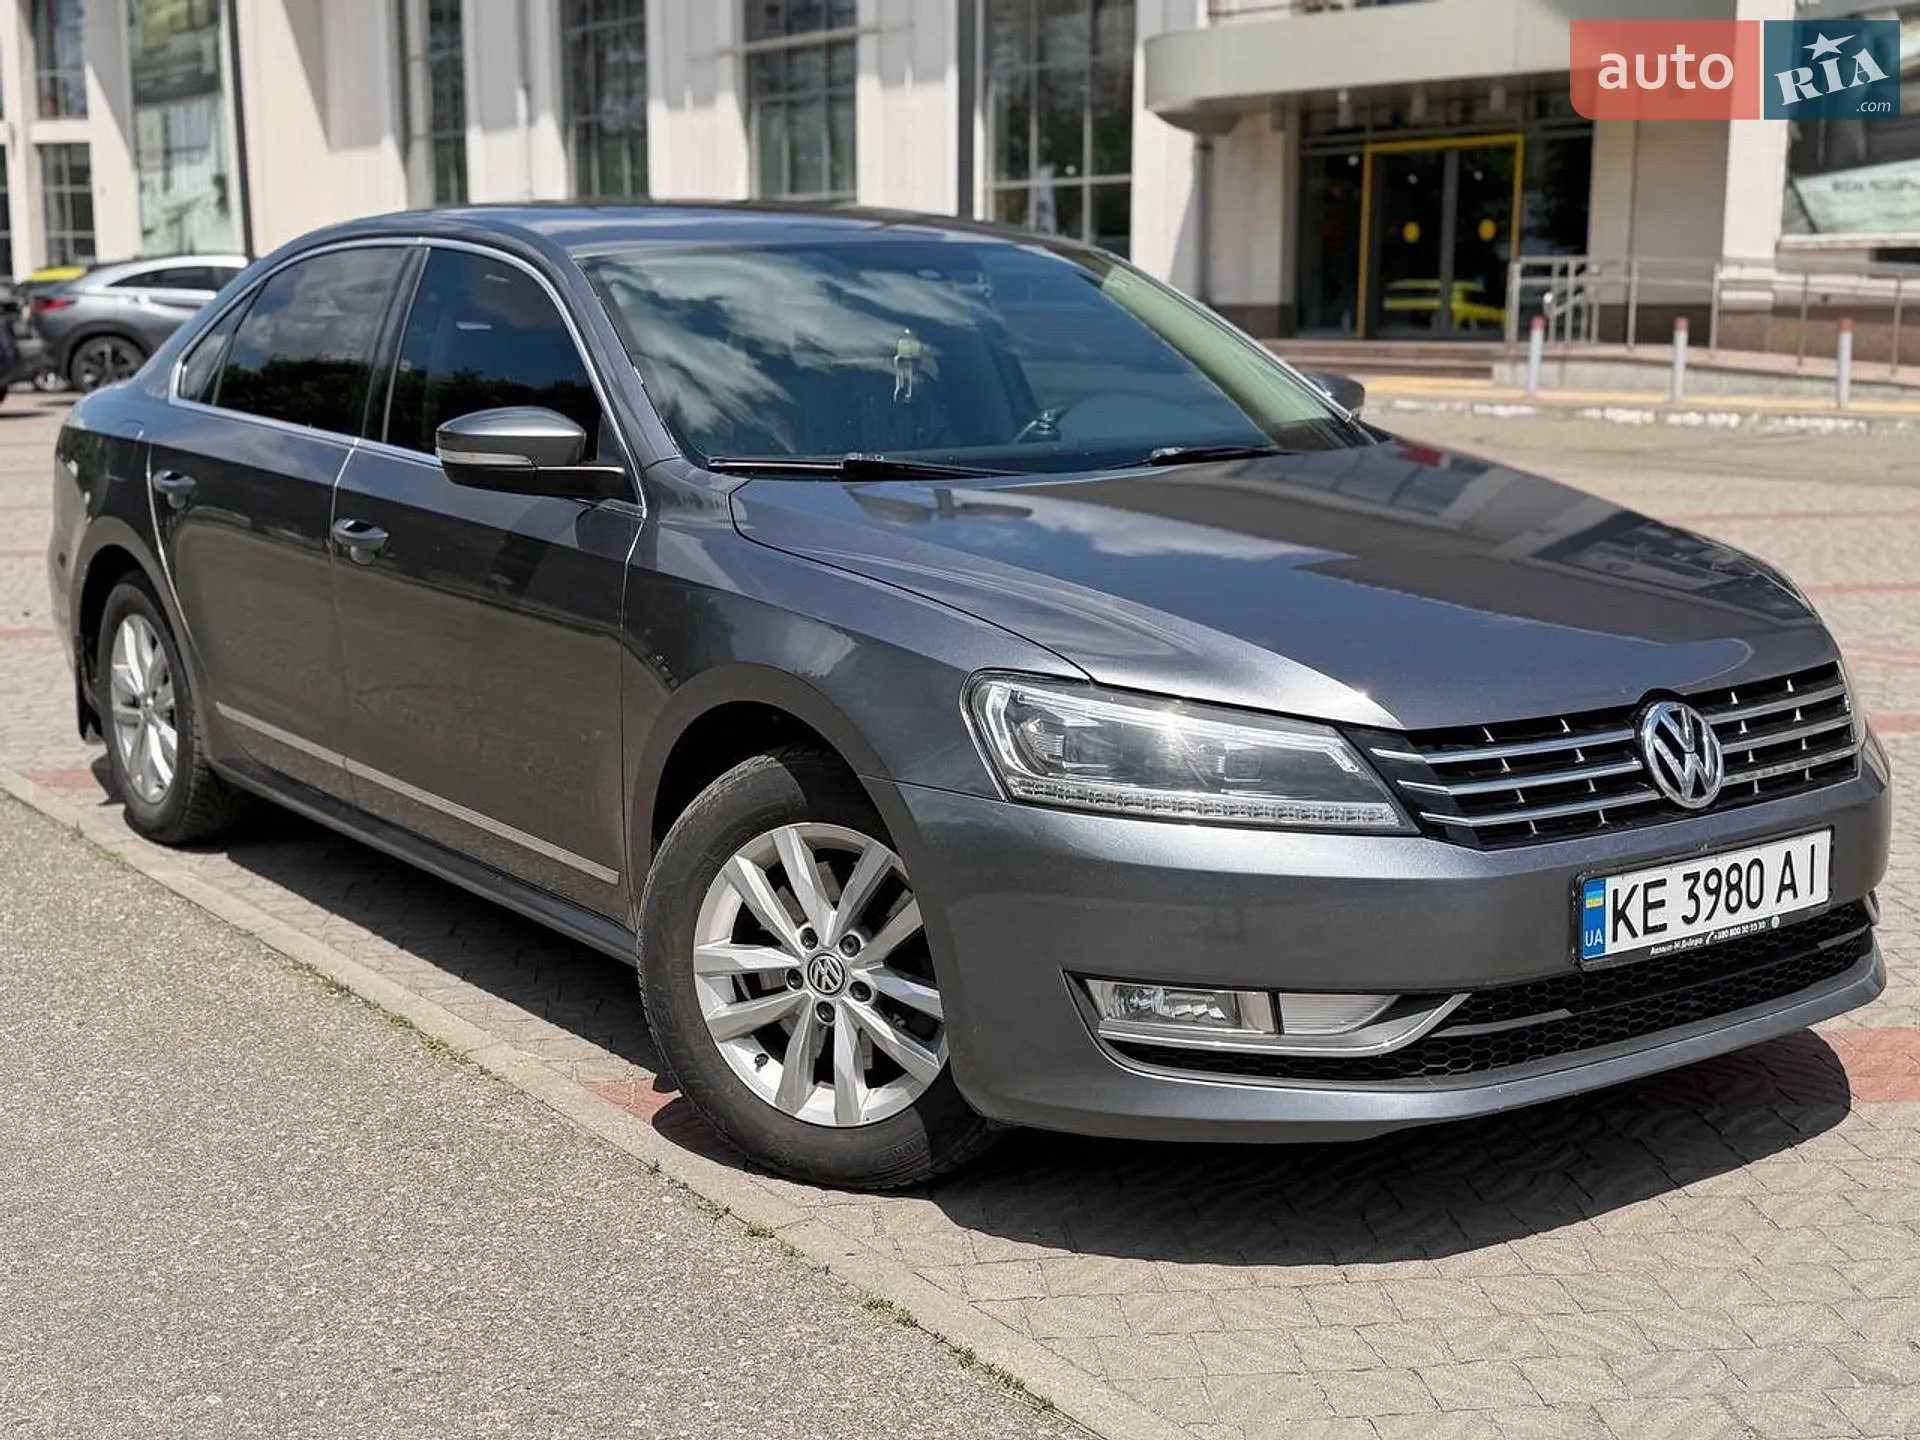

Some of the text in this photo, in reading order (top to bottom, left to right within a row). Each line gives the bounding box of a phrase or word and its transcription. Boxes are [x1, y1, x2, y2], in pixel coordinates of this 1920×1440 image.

[1611, 878, 1668, 943] KE
[1681, 857, 1765, 926] 3980
[1585, 930, 1604, 947] UA
